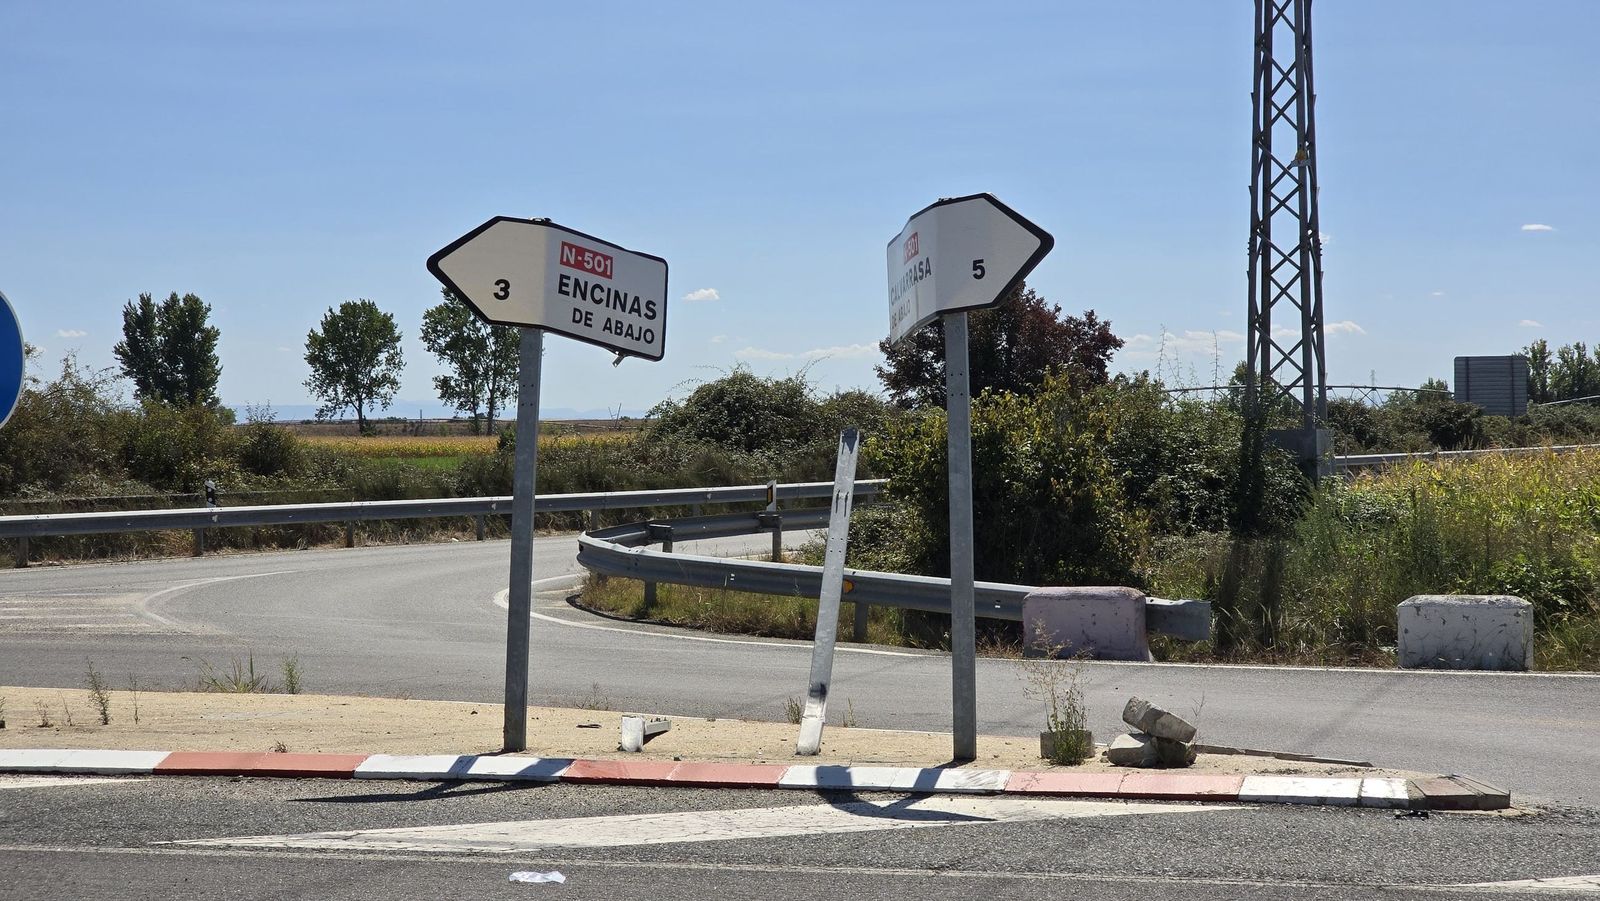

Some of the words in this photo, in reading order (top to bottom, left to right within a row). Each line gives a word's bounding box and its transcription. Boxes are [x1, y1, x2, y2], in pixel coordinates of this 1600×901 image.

[562, 246, 613, 276] N-501
[972, 259, 986, 280] 5
[493, 279, 511, 300] 3
[558, 273, 657, 321] ENCINAS
[571, 308, 594, 328] DE
[602, 317, 655, 345] ABAJO
